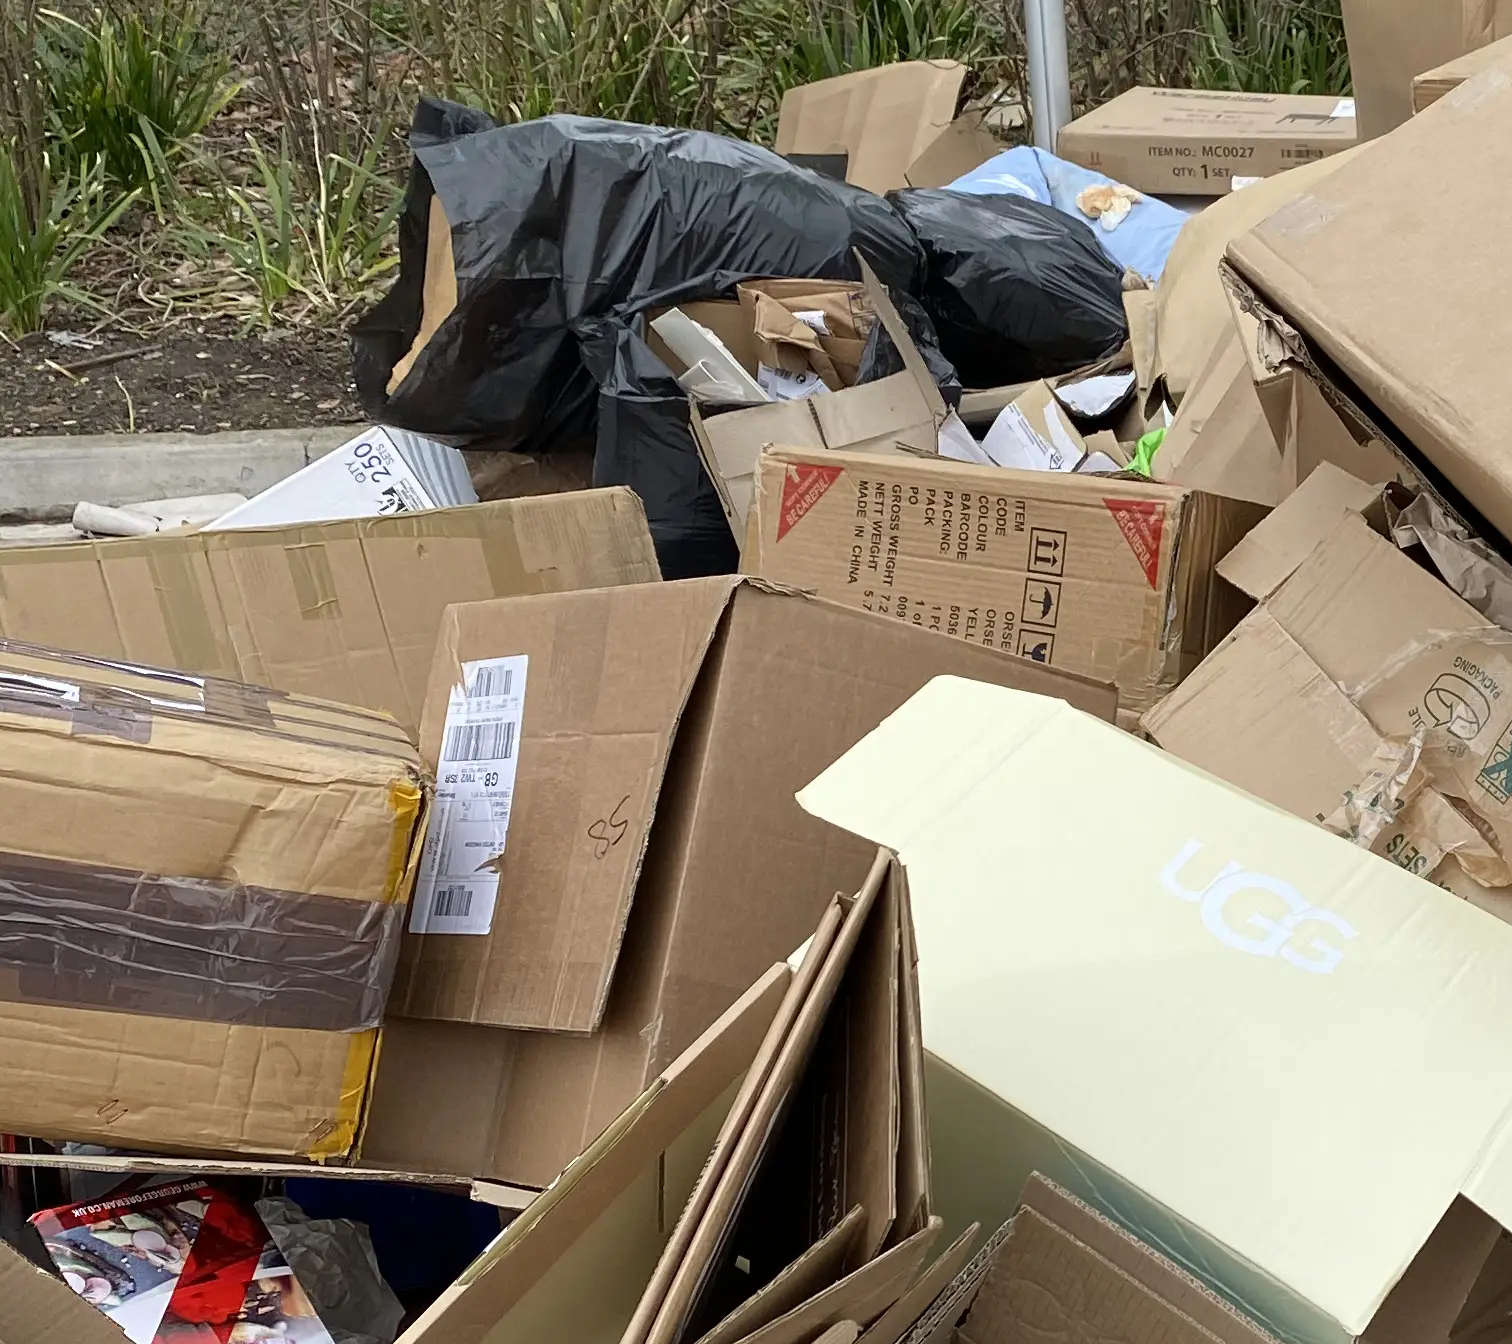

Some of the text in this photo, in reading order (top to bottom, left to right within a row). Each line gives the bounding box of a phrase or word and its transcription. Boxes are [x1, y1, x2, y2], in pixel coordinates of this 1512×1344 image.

[1148, 146, 1175, 157] ITEM
[1202, 146, 1254, 159] MC0027
[1172, 163, 1231, 180] QTY: 1 SET
[344, 461, 366, 483] QTY
[354, 443, 392, 483] 250
[874, 482, 885, 516] NETT
[889, 484, 902, 531] GROSS
[908, 486, 919, 505] PO
[924, 488, 936, 526] PACK
[785, 509, 800, 526] BE
[847, 480, 869, 584] MADE IN CHINA
[939, 490, 954, 554] PACKING:
[957, 493, 971, 561] BARCODE
[975, 495, 989, 552] COLOUR
[995, 498, 1007, 537] CODE
[1014, 500, 1026, 532] ITEM
[867, 521, 883, 572] WEIGHT
[882, 535, 899, 587] WEIGHT
[1454, 656, 1502, 701] PACKAGING
[484, 772, 499, 787] GB
[1159, 837, 1360, 974] UGG
